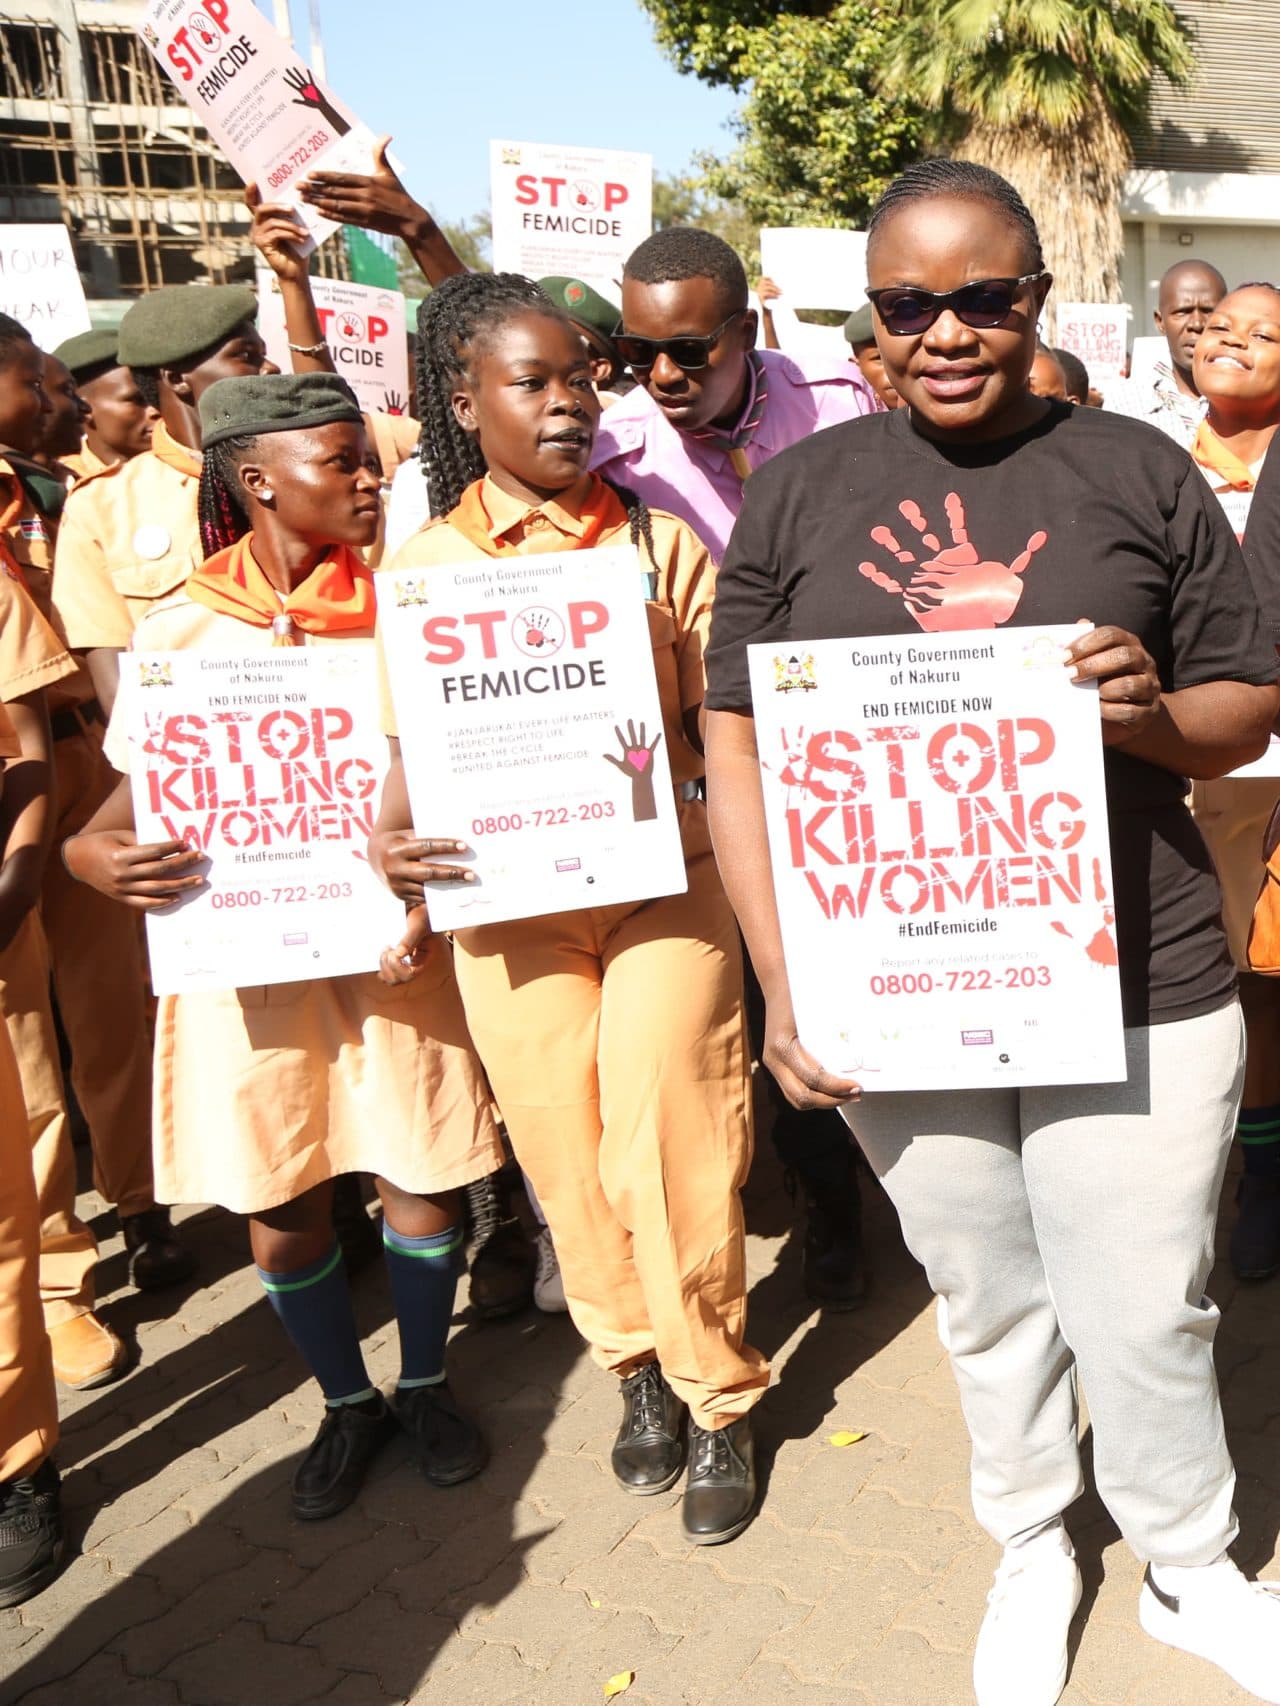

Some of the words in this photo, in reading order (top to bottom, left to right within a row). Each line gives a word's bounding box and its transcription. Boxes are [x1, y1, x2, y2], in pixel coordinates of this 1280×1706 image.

[196, 34, 258, 106] FEMICIDE
[267, 130, 330, 188] 0800-722-203
[523, 213, 622, 237] FEMICIDE
[316, 308, 389, 344] TOP
[1066, 322, 1118, 337] STOP
[1061, 336, 1121, 352] KILLING
[333, 346, 384, 368] ICIDE
[1077, 351, 1120, 363] OMEN
[454, 571, 493, 585] County
[496, 564, 564, 581] Government
[483, 586, 495, 598] of
[498, 584, 538, 597] Nakuru
[200, 659, 239, 671] County
[243, 657, 309, 670] Government
[852, 650, 902, 667] County
[907, 644, 996, 664] Government
[229, 674, 241, 684] of
[244, 673, 284, 683] Nakuru
[442, 660, 607, 704] FEMICIDE
[890, 670, 903, 685] of
[909, 668, 960, 684] Nakuru
[208, 696, 229, 706] END
[233, 694, 280, 705] FEMICIDE
[284, 692, 307, 703] NOW
[863, 703, 889, 718] END
[894, 698, 958, 717] FEMICIDE
[962, 696, 992, 712] NOW
[163, 707, 354, 766] STOP
[805, 717, 1056, 802] STOP
[146, 758, 377, 814] KILLING
[472, 801, 616, 836] 0800-722-203
[786, 791, 1087, 868] KILLING
[234, 848, 312, 864] #EndFemicide
[211, 882, 353, 909] 0800-722-203
[898, 918, 998, 938] #EndFemicide
[870, 965, 1052, 996] 0800-722-203
